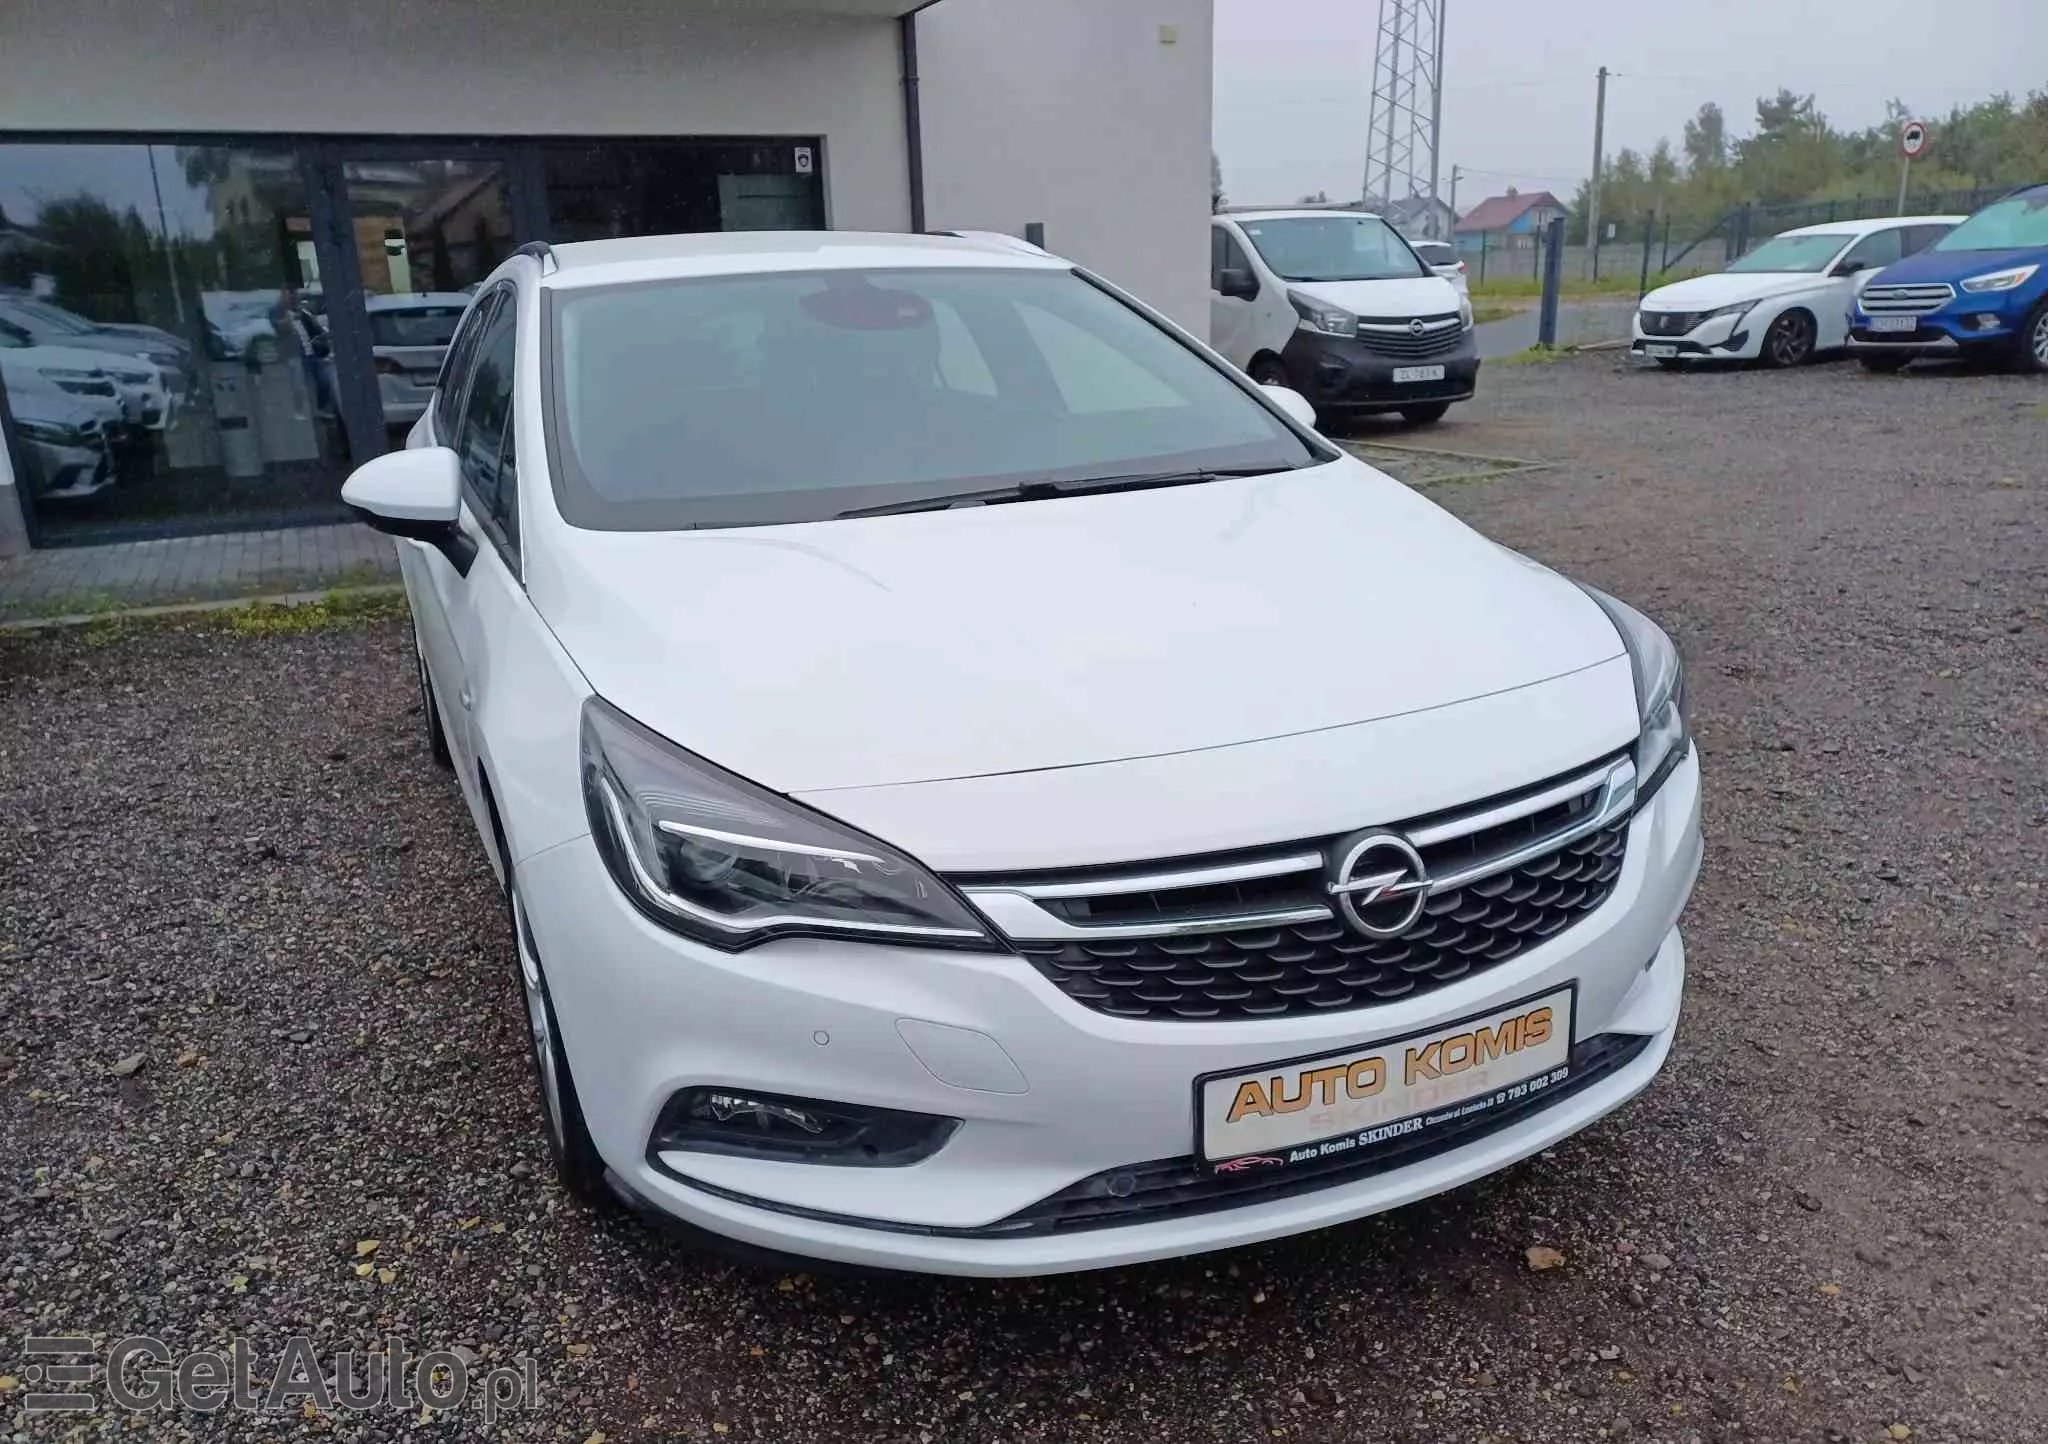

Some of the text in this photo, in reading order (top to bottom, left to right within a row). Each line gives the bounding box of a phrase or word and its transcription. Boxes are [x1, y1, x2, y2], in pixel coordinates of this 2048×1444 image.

[1227, 1007, 1552, 1122] AUTO KOMIS
[1289, 1147, 1318, 1163] Auto
[1320, 1136, 1356, 1155] Komis
[1358, 1117, 1424, 1146] SKINDER
